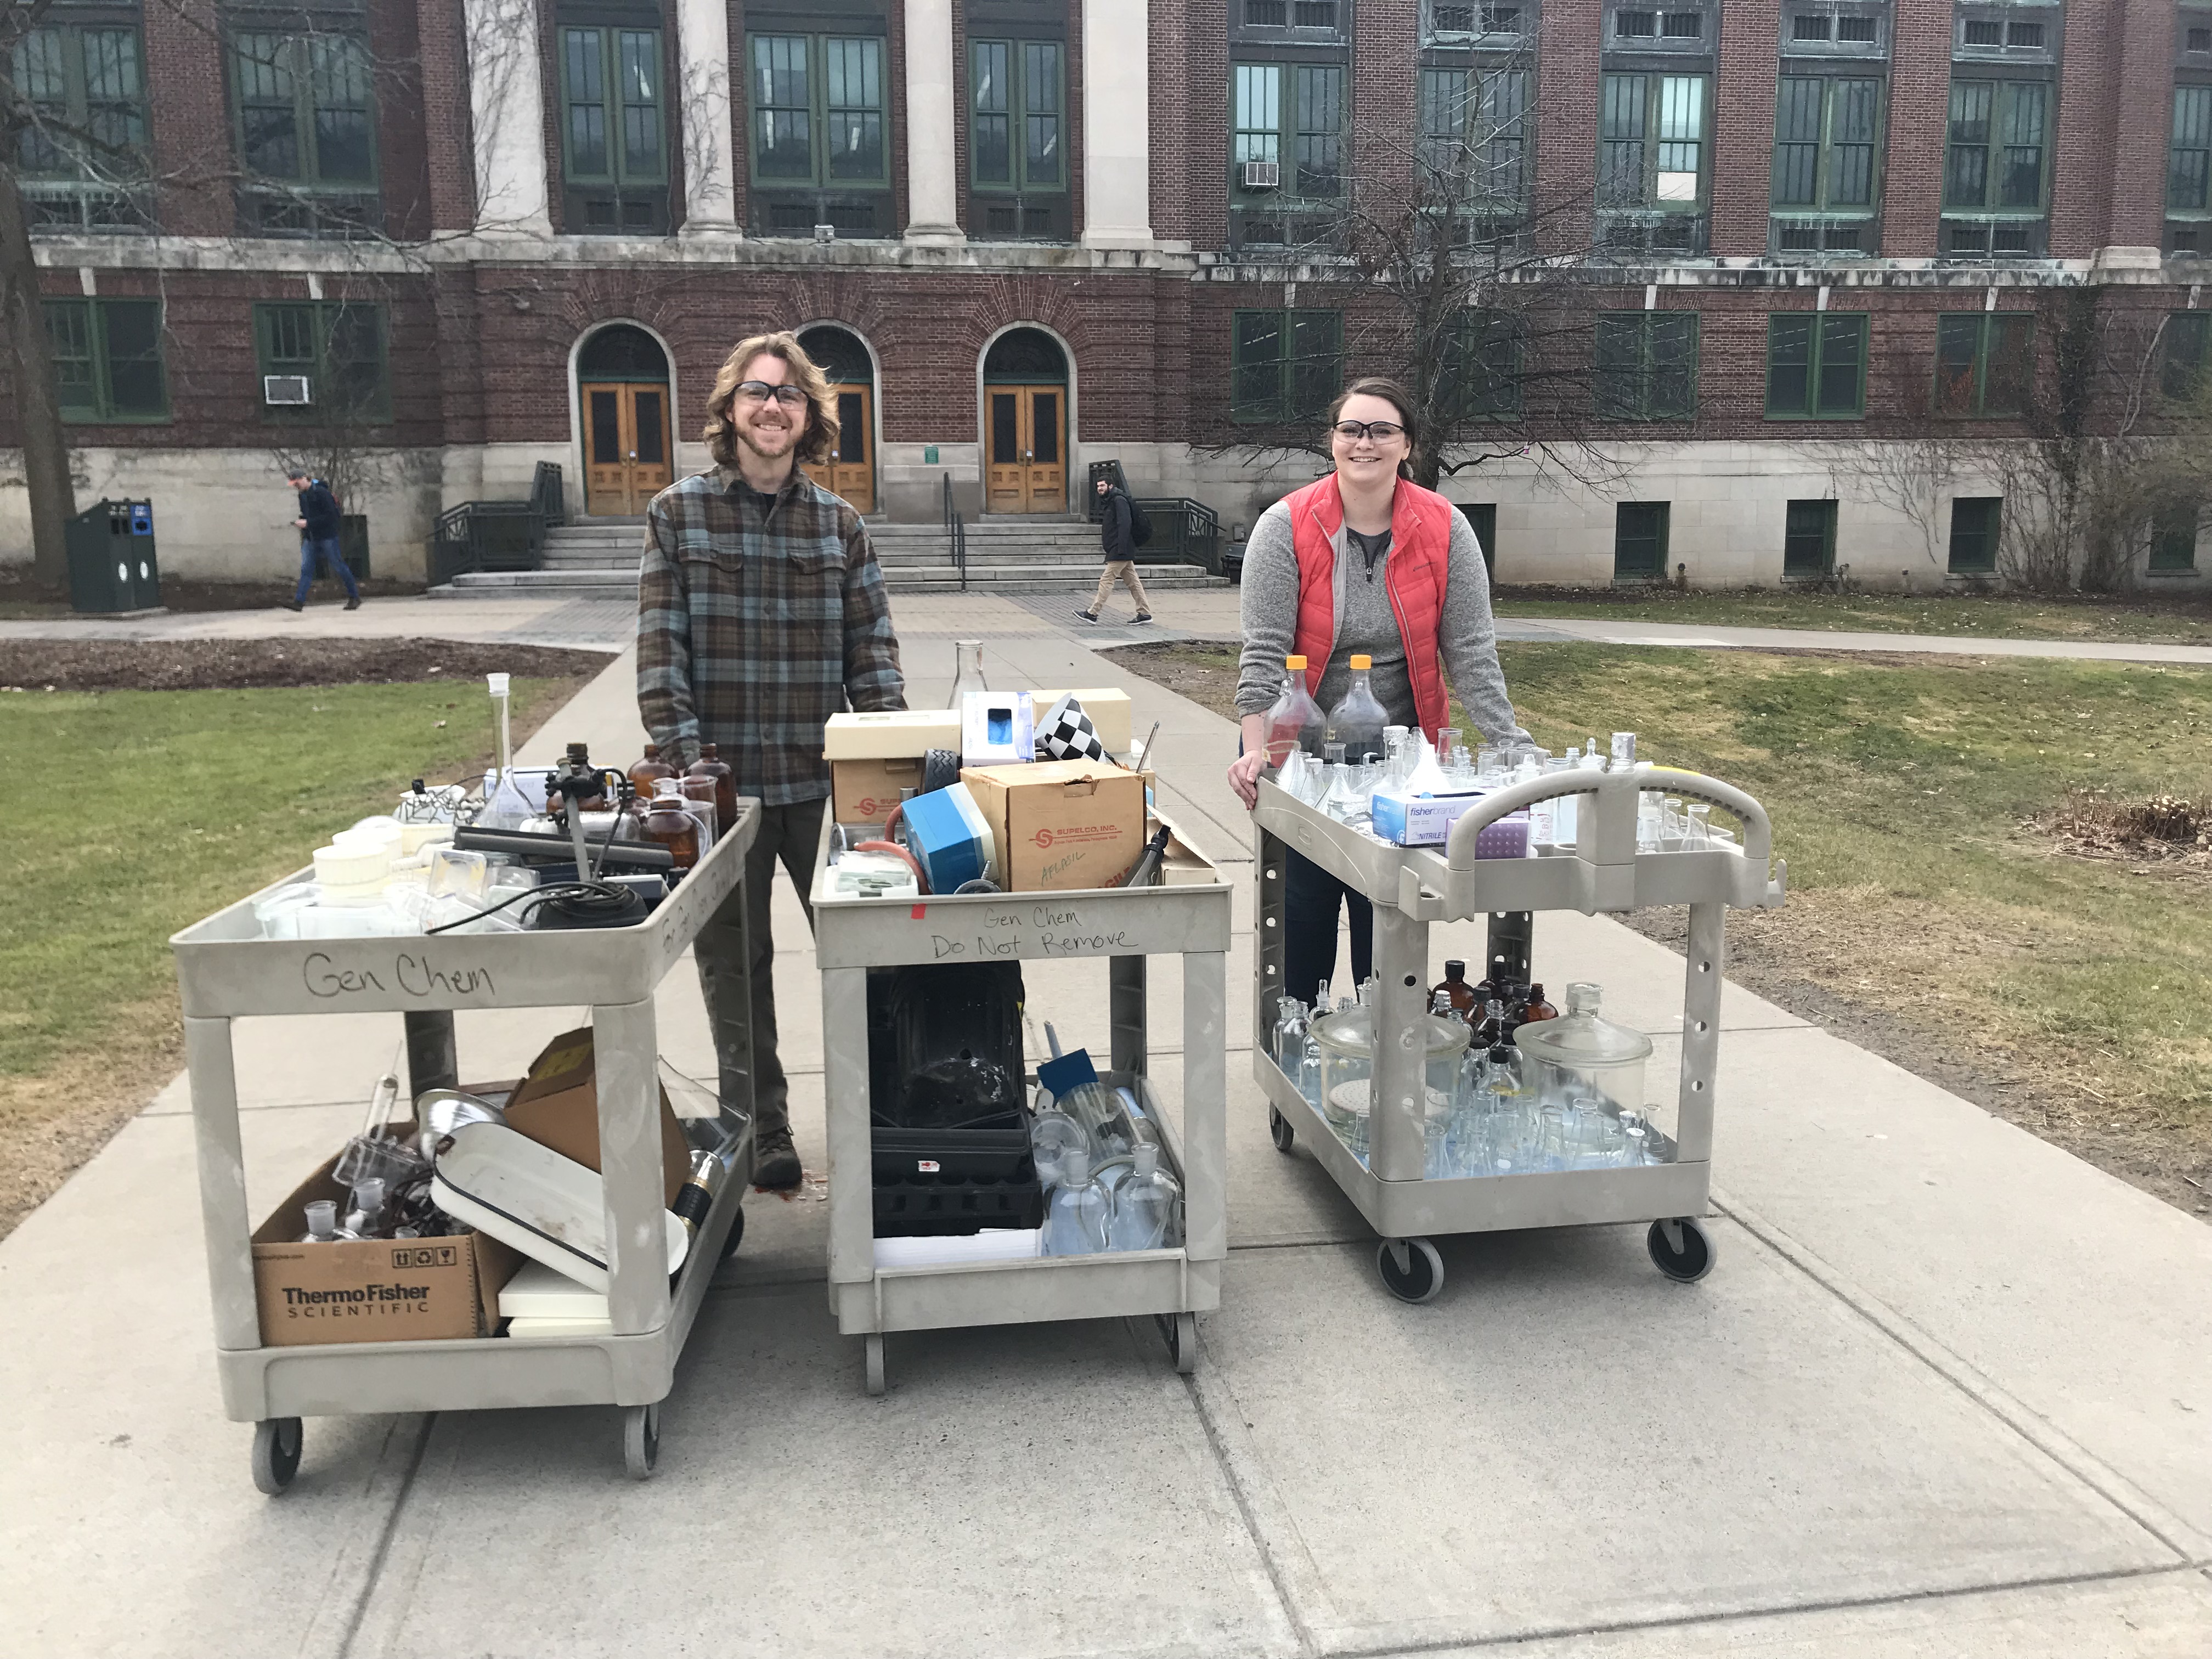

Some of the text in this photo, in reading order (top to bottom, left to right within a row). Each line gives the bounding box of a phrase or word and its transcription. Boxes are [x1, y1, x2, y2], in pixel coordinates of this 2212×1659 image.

[1410, 805, 1455, 816] fisherbrand
[1057, 826, 1098, 835] SUPELCO,
[1419, 832, 1442, 840] NITRILE
[984, 907, 1082, 928] Gen Chem
[931, 931, 1138, 958] Do Not Remove
[303, 952, 495, 997] Gen Chem
[288, 1302, 428, 1318] SCIENTIFIC
